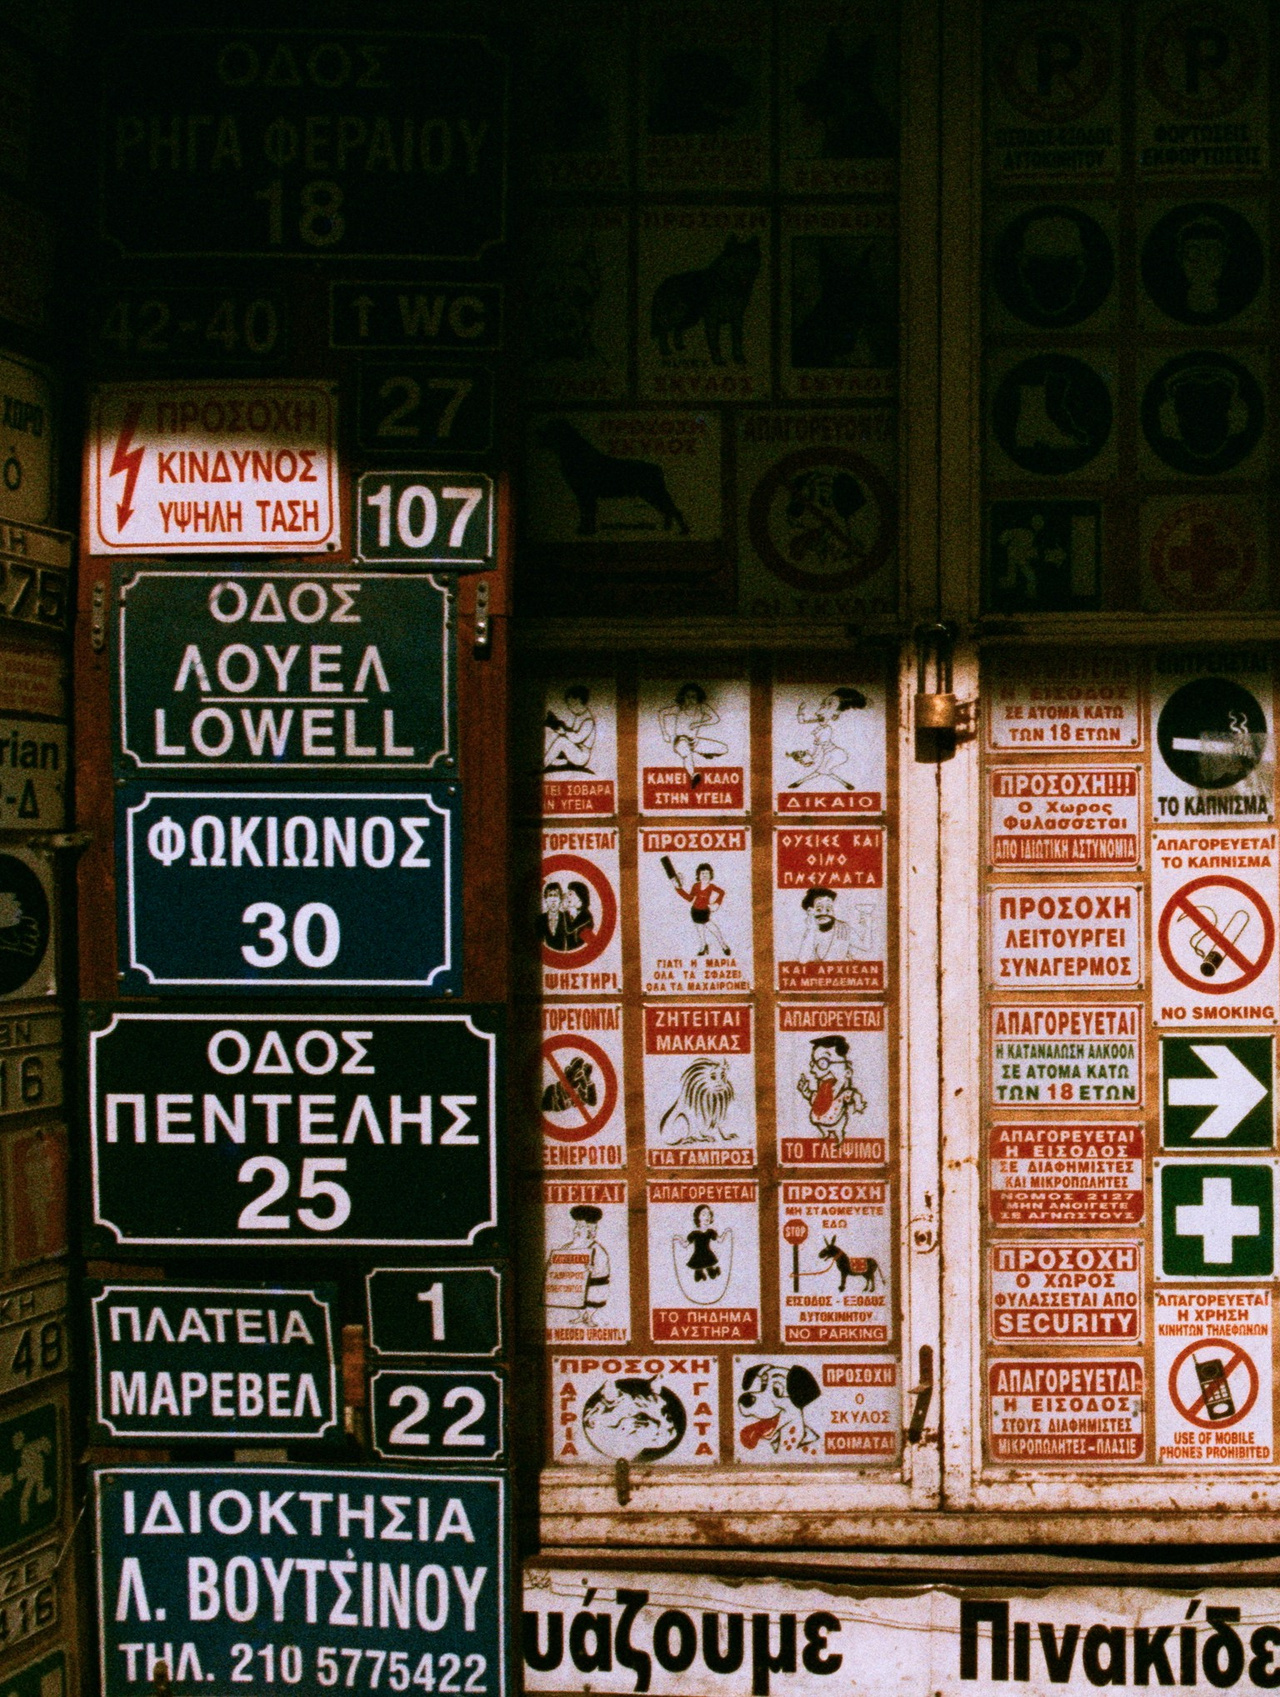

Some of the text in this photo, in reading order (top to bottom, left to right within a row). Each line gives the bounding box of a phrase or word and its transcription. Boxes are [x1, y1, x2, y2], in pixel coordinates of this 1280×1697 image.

[216, 41, 391, 88] ΟΔΟΣ
[113, 115, 490, 175] ΡΗΓΑ ΦΕΡΑΙΟΥ
[254, 180, 347, 246] 18
[103, 298, 279, 353] 42-40
[399, 295, 486, 339] WC
[377, 376, 474, 438] 27
[156, 400, 318, 435] ΠΡΟΣΟΧΗ
[157, 450, 318, 484] ΚΙΝΔΥΝΟΣ
[158, 500, 320, 534] ΥΨΗΛΗ ΤΑΣΗ
[366, 485, 484, 549] 107
[208, 582, 362, 623] ΟΔΟΣ
[173, 644, 391, 693] ΛΟΥΕΛ
[1028, 706, 1079, 719] ΑΤΟΜΑ
[1084, 706, 1125, 719] ΚΑΤΩ
[154, 708, 416, 757] LOWELL
[1009, 724, 1121, 742] ΤΩΝ 18 ΕΤΩΝ
[647, 773, 740, 785] ΚΑΝΕΙ ΚΑΛΟ
[655, 792, 733, 805] ΣΤΗΝ ΥΓΕΙΑ
[787, 796, 874, 809] ΔΙΚΑΙΟ
[1158, 796, 1268, 817] ΤΟ ΚΑΠΝΙΣΜΑ
[147, 815, 431, 869] ΦΩΚΙΩΝΟΣ
[649, 832, 742, 849] ΠΡΟΣΟΧΗ
[1157, 837, 1276, 851] ΑΠΑΓΟΡΕΥΕΤΑΙ
[1162, 857, 1272, 869] ΤΟ ΚΑΠΝΙΣΜΑ
[1000, 896, 1131, 920] ΠΡΟΣΟΧΗ
[240, 901, 341, 968] 30
[1005, 928, 1126, 948] ΛΕΙΤΟΥΡΓΕΙ
[1000, 957, 1132, 977] ΣΥΝΑΓΕΡΜΟΣ
[655, 1010, 740, 1027] ΖΗΤΕΙΤΑΙ
[784, 1010, 881, 1028] ΑΠΑΓΟΡΕΥΕΤΑΙ
[1162, 1006, 1275, 1020] NO SMOKING
[996, 1011, 1136, 1036] ΑΠΑΓΟΡΕΥΕΤΑΙ
[207, 1029, 376, 1075] ΟΔΟΣ
[656, 1035, 741, 1051] ΜΑΚΑΚΑΣ
[1001, 1065, 1129, 1079] ΣΕ ΑΤΟΜΑ ΚΑΤΩ
[996, 1083, 1136, 1101] ΤΩΝ 18 ΕΤΩΝ
[105, 1094, 480, 1145] ΠΕΝΤΕΛΗΣ
[1000, 1130, 1135, 1143] ΑΠΑΓΟΡΕΥΕΤΑΙ
[651, 1149, 751, 1166] ΓΙΑ ΓΑΜΠΡΟΣ
[1033, 1145, 1128, 1158] ΕΙΣΟΔΟΣ
[1027, 1161, 1134, 1173] ΔΙΑΦΗΜΙΣΤΕΣ
[236, 1155, 352, 1231] 25
[652, 1185, 754, 1200] ΑΠΑΓΟΡΕΥΕΤΑΙ
[787, 1186, 881, 1200] ΠΡΟΣΟΧΗ
[784, 1225, 806, 1239] STOP
[1000, 1249, 1134, 1270] ΠΡΟΣΟΧΗ
[1043, 1273, 1116, 1288] ΧΩΡΟΣ
[994, 1292, 1137, 1308] ΦΥΛΑΣΣΕΤΑΙ ΑΠΟ
[1157, 1294, 1269, 1307] ΑΠΑΓΟΡΕΥΕΤΑΙ
[417, 1281, 446, 1342] 1
[688, 1311, 753, 1323] ΠΗΔΗΜΑ
[109, 1306, 315, 1346] ΠΛΑΤΕΙΑ
[670, 1325, 741, 1338] ΑΥΣΤΗΡΑ
[1000, 1312, 1134, 1334] SECURITY
[1158, 1324, 1269, 1336] ΚΙΝΗΤΩΝ ΤΗΛΕΦΩΝΩΝ
[789, 1327, 885, 1340] NO PARKING
[560, 1359, 711, 1375] ΠΡΟΣΟΧΗ
[826, 1366, 893, 1384] ΠΡΟΣΟΧΗ
[997, 1368, 1137, 1393] ΑΠΑΓΟΡΕΥΕΤΑΙ
[110, 1371, 323, 1418] ΜΑΡΕΒΕΛ
[1032, 1397, 1131, 1412] ΕΙΣΟΔΟΣ
[387, 1385, 487, 1447] 22
[831, 1411, 890, 1424] ΣΚΥΛΟΣ
[1001, 1418, 1041, 1433] ΣΤΟΥΣ
[1174, 1431, 1255, 1445] USE OF MOBILE
[1159, 1446, 1270, 1460] PHONES PROHIBITED
[123, 1490, 476, 1544] ΙΔΙΟΚΤΗΣΙΑ
[115, 1557, 167, 1623] Λ.
[118, 1642, 488, 1695] ΤΗΛ. 210 5775422
